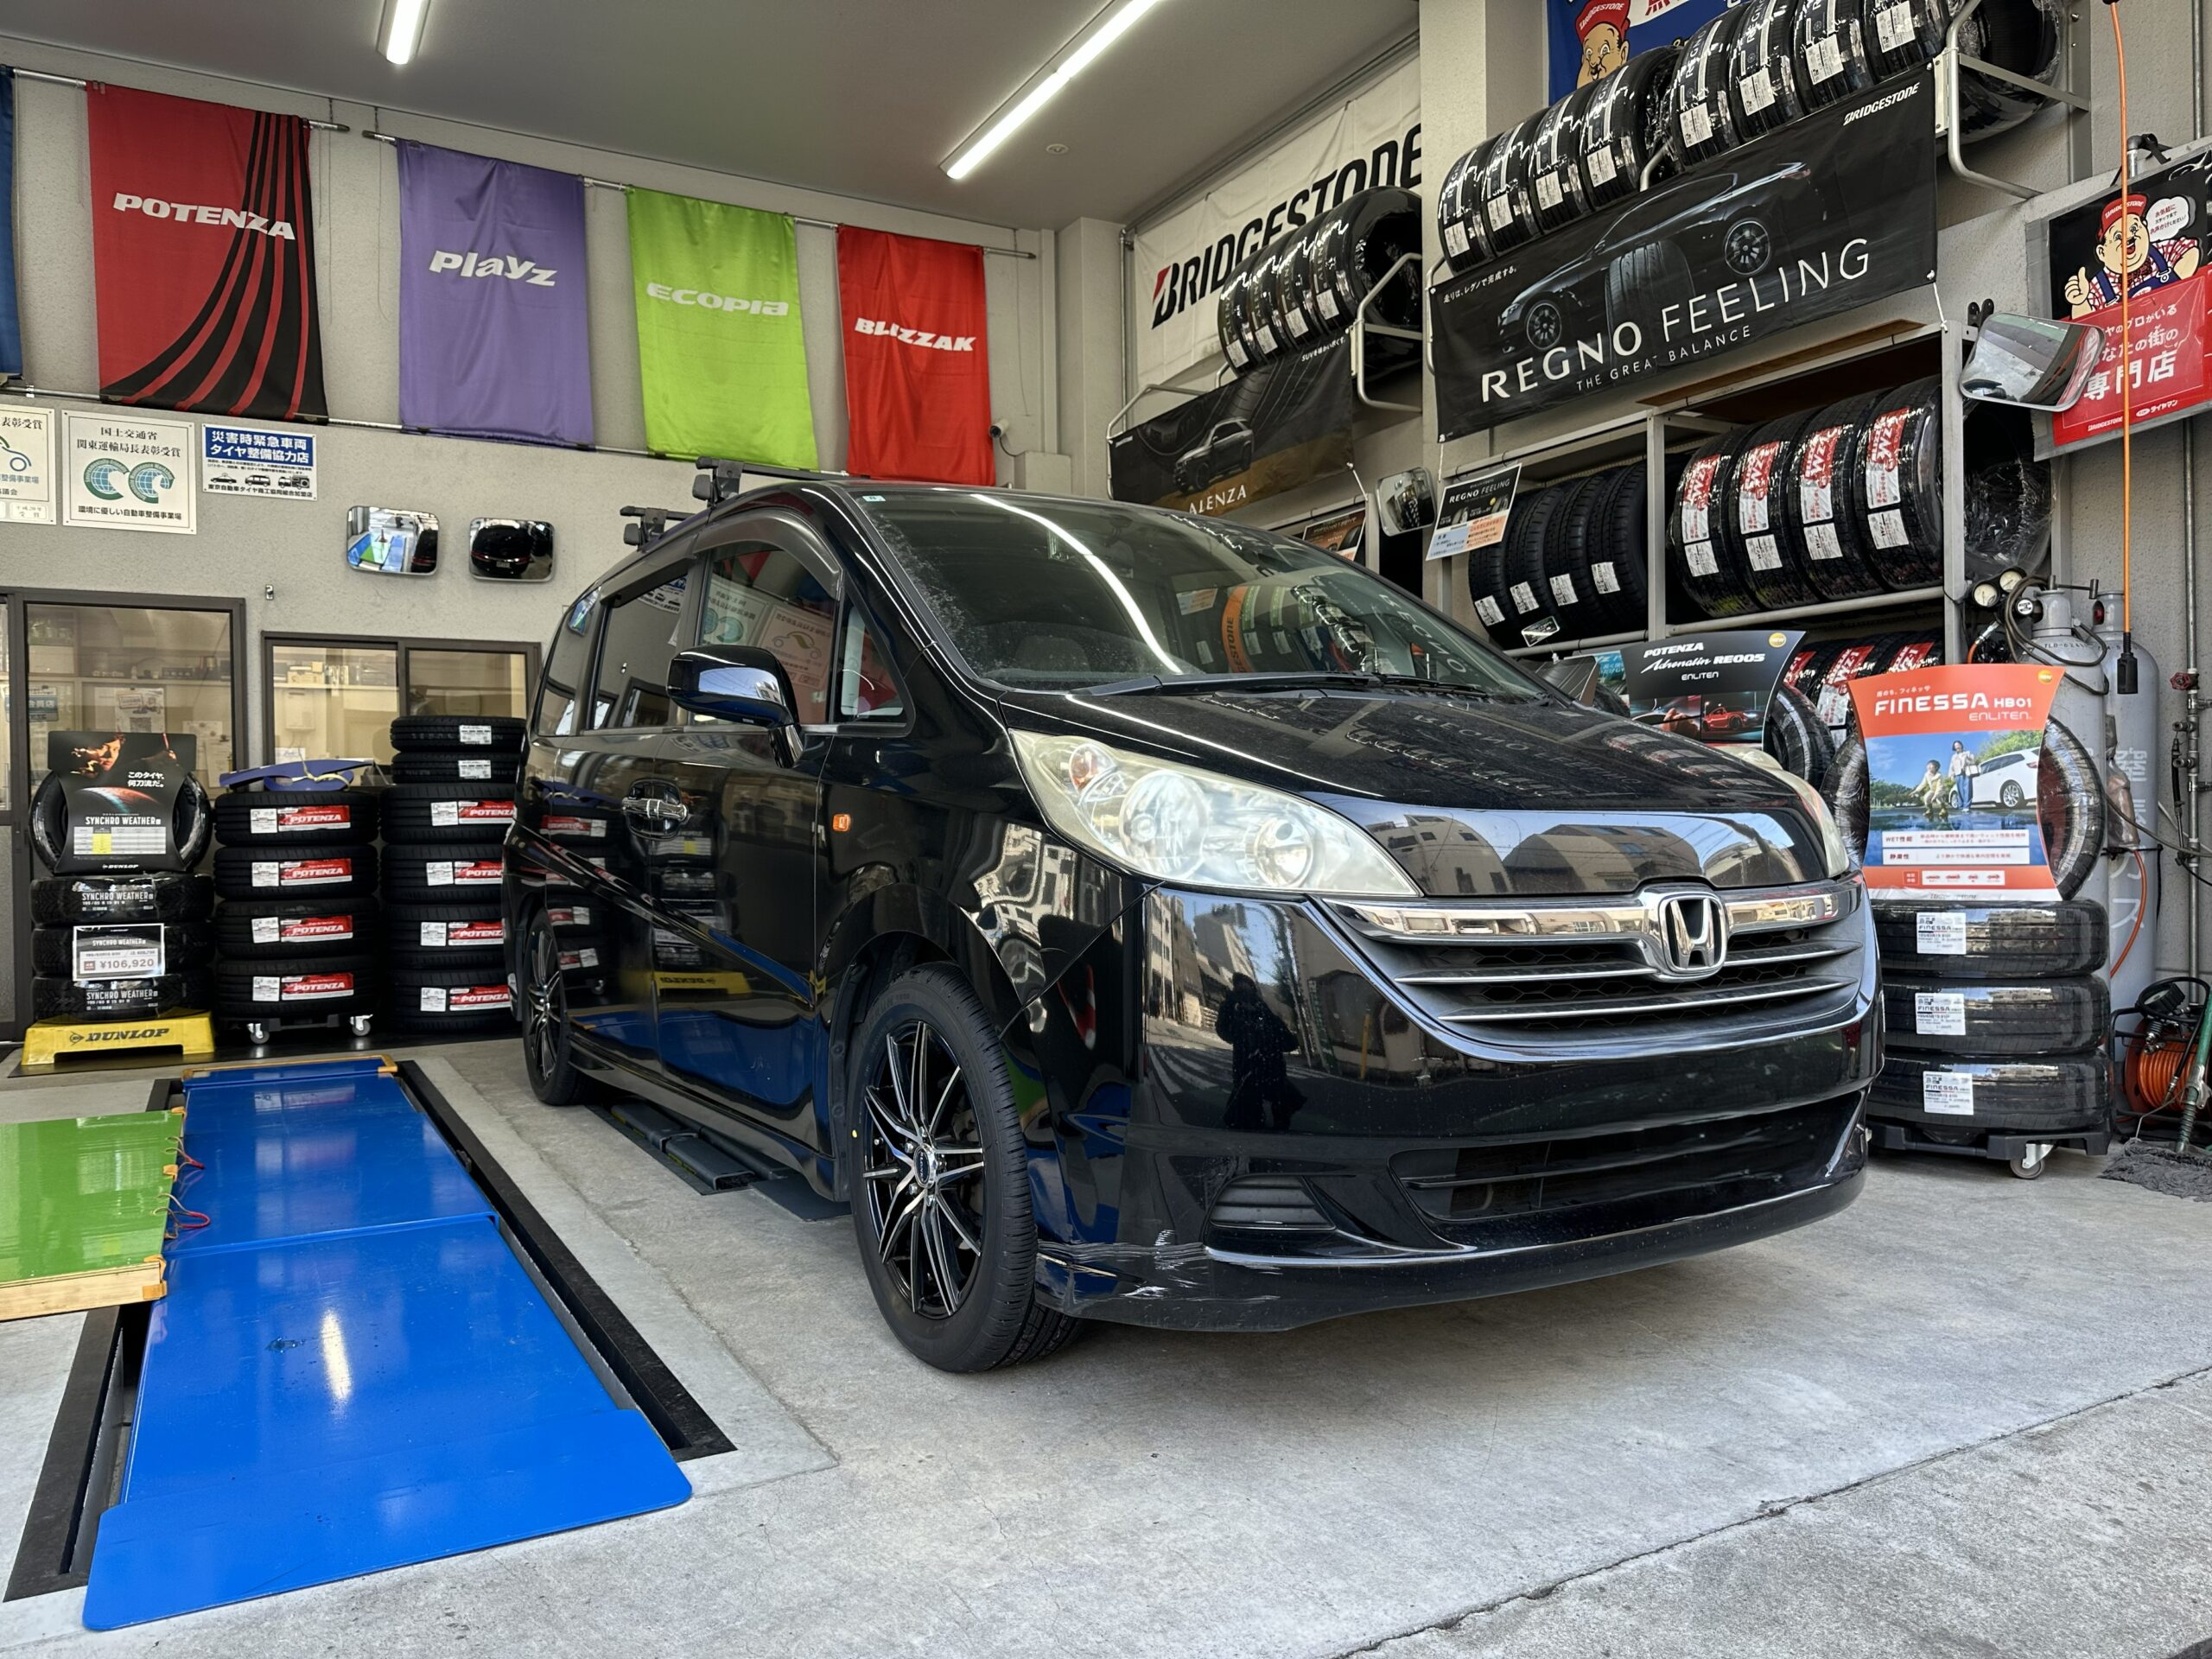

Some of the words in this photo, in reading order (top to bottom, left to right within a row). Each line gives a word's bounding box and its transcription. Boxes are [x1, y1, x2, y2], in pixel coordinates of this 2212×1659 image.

[1844, 83, 1920, 125] BRIDGESTONE
[113, 193, 296, 240] POTENZA
[1152, 123, 1421, 329] BRIDGESTONE
[429, 250, 558, 287] Playz
[646, 282, 790, 316] ECOPIA
[1482, 321, 1642, 402] REGNO
[1662, 238, 1868, 342] FEELING
[854, 317, 976, 351] BLIZZAK
[1576, 376, 1602, 391] THE
[1668, 325, 1751, 362] BALANCE
[2084, 348, 2177, 401] 専門店
[100, 426, 158, 441] 国土交通省
[211, 430, 308, 451] 災害時緊急車両
[76, 439, 181, 458] 関東運輸局長表彰受賞
[210, 444, 309, 464] タイヤ整備協力店
[1189, 485, 1246, 515] ALENZA
[1449, 489, 1478, 504] REGNO
[1480, 478, 1510, 495] FEELING
[78, 505, 182, 520] 環境に優しい自動車整備事業場
[1643, 642, 1704, 658] POTENZA
[1641, 658, 1712, 674] Adrenalin
[1713, 653, 1765, 664] RE005
[1681, 671, 1719, 681] ENLITEN
[1875, 692, 1989, 716] FINESSA
[1994, 697, 2031, 709] HB01
[86, 817, 119, 825] SYNCHRO
[290, 815, 341, 823] POTENZA
[292, 868, 343, 877] POTENZA
[293, 925, 344, 934] POTENZA
[100, 959, 154, 969] ¥106,920
[86, 991, 118, 1000] SYNCHRO
[121, 989, 153, 998] WEATHER
[294, 982, 346, 991] POTENZA
[86, 1028, 169, 1042] DUNLOP
